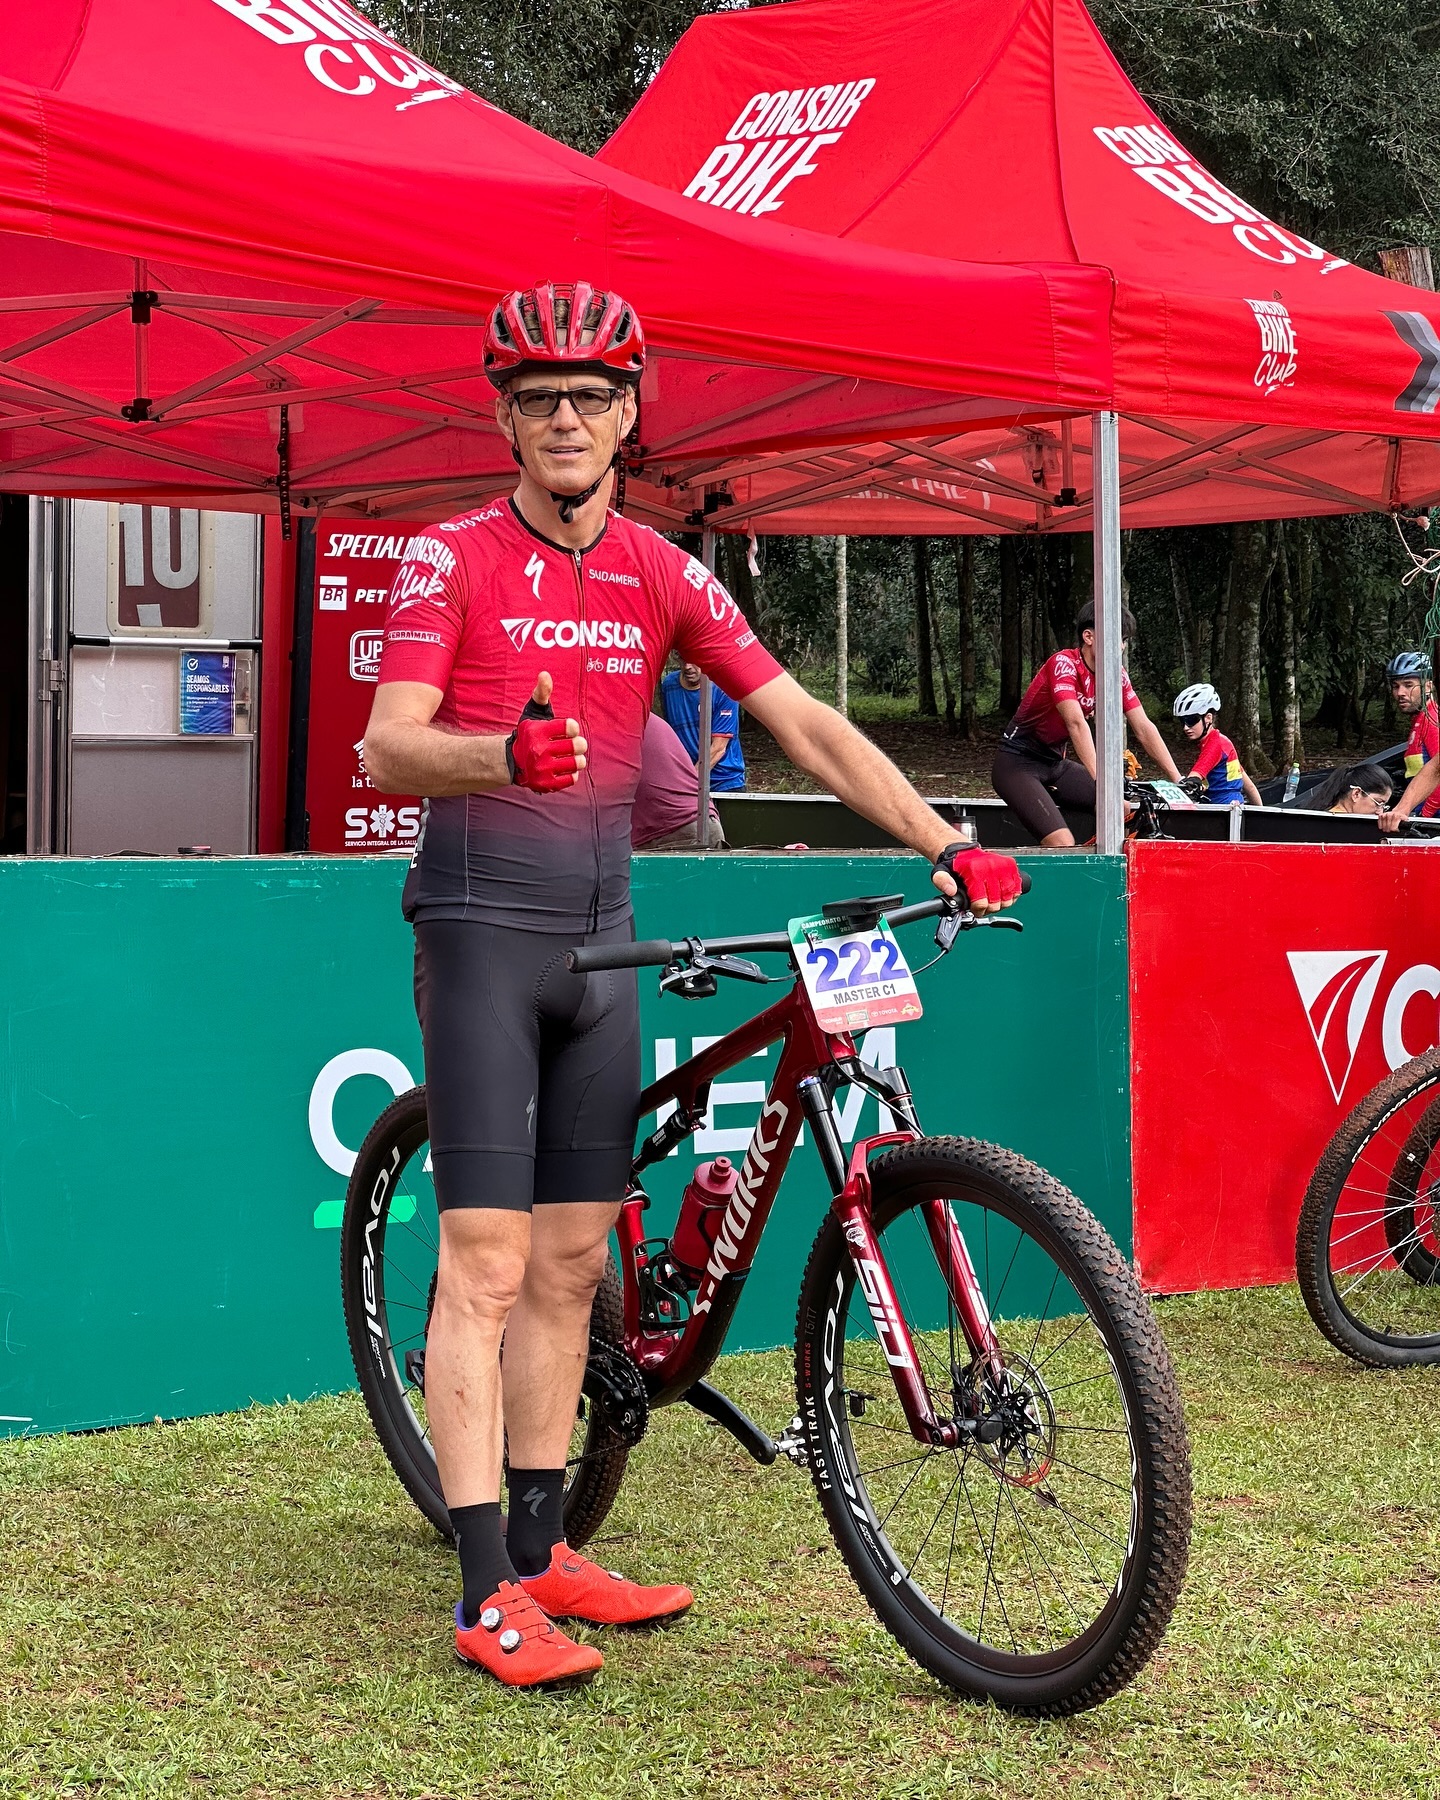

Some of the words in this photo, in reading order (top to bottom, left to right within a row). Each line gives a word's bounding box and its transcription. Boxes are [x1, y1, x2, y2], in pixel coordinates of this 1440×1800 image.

[725, 77, 877, 142] CONSUR
[681, 131, 844, 218] BIKE
[1254, 313, 1299, 355] BIKE
[1253, 352, 1298, 387] Club
[457, 508, 504, 530] TOYOTA
[588, 568, 641, 588] SUDAMERIS
[323, 588, 344, 602] BR
[414, 632, 440, 643] MATE
[533, 619, 646, 652] CONSUR
[186, 675, 210, 683] SEAMOS
[360, 665, 381, 674] FRIG
[606, 657, 644, 675] BIKE
[186, 684, 230, 693] RESPONSABLES
[351, 775, 363, 788] la
[806, 938, 910, 994] 222
[833, 985, 881, 1005] MASTER
[882, 983, 897, 996] C1
[692, 1099, 789, 1316] S-WORKS
[804, 1342, 812, 1389] S-WORKS
[808, 1395, 822, 1442] TRAK
[814, 1443, 832, 1490] FAST
